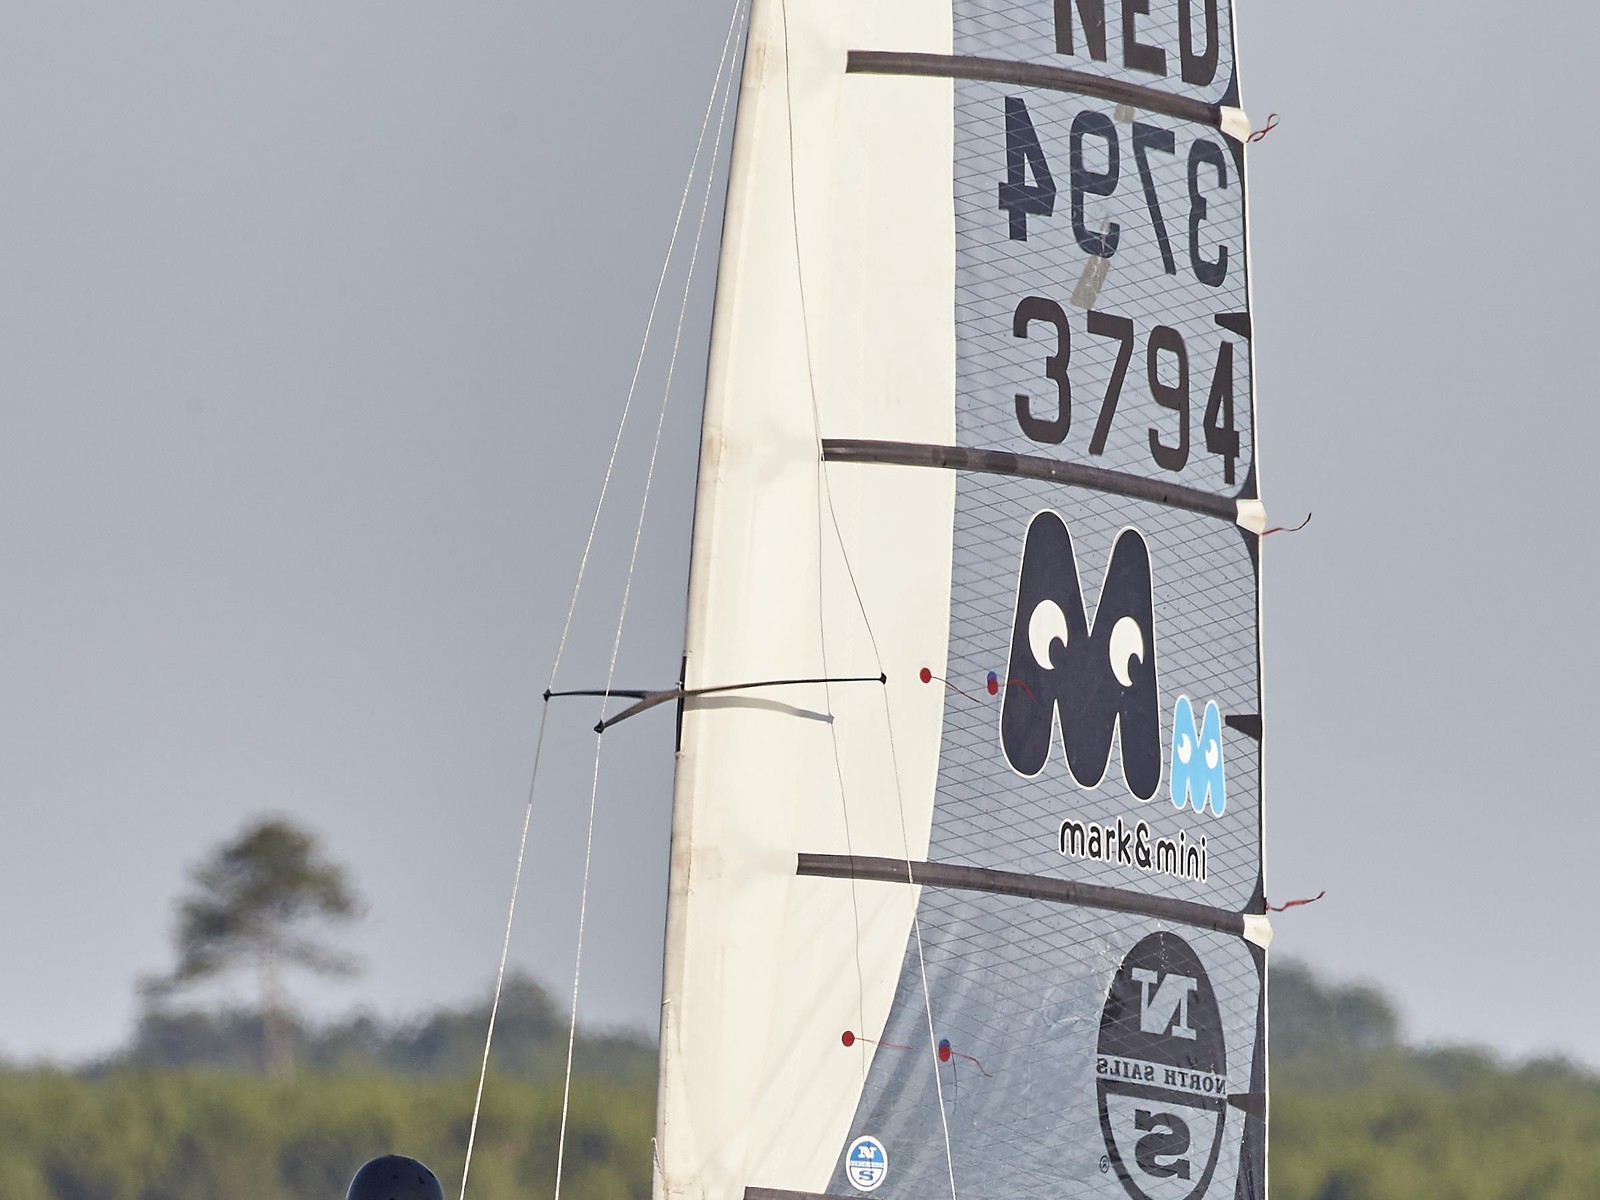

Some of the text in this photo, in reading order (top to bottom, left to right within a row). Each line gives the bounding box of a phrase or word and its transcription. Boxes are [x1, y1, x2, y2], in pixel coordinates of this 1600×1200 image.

[1013, 296, 1240, 485] 3794
[1059, 817, 1208, 882] mark&mini
[857, 1146, 877, 1159] N
[858, 1170, 875, 1181] S
